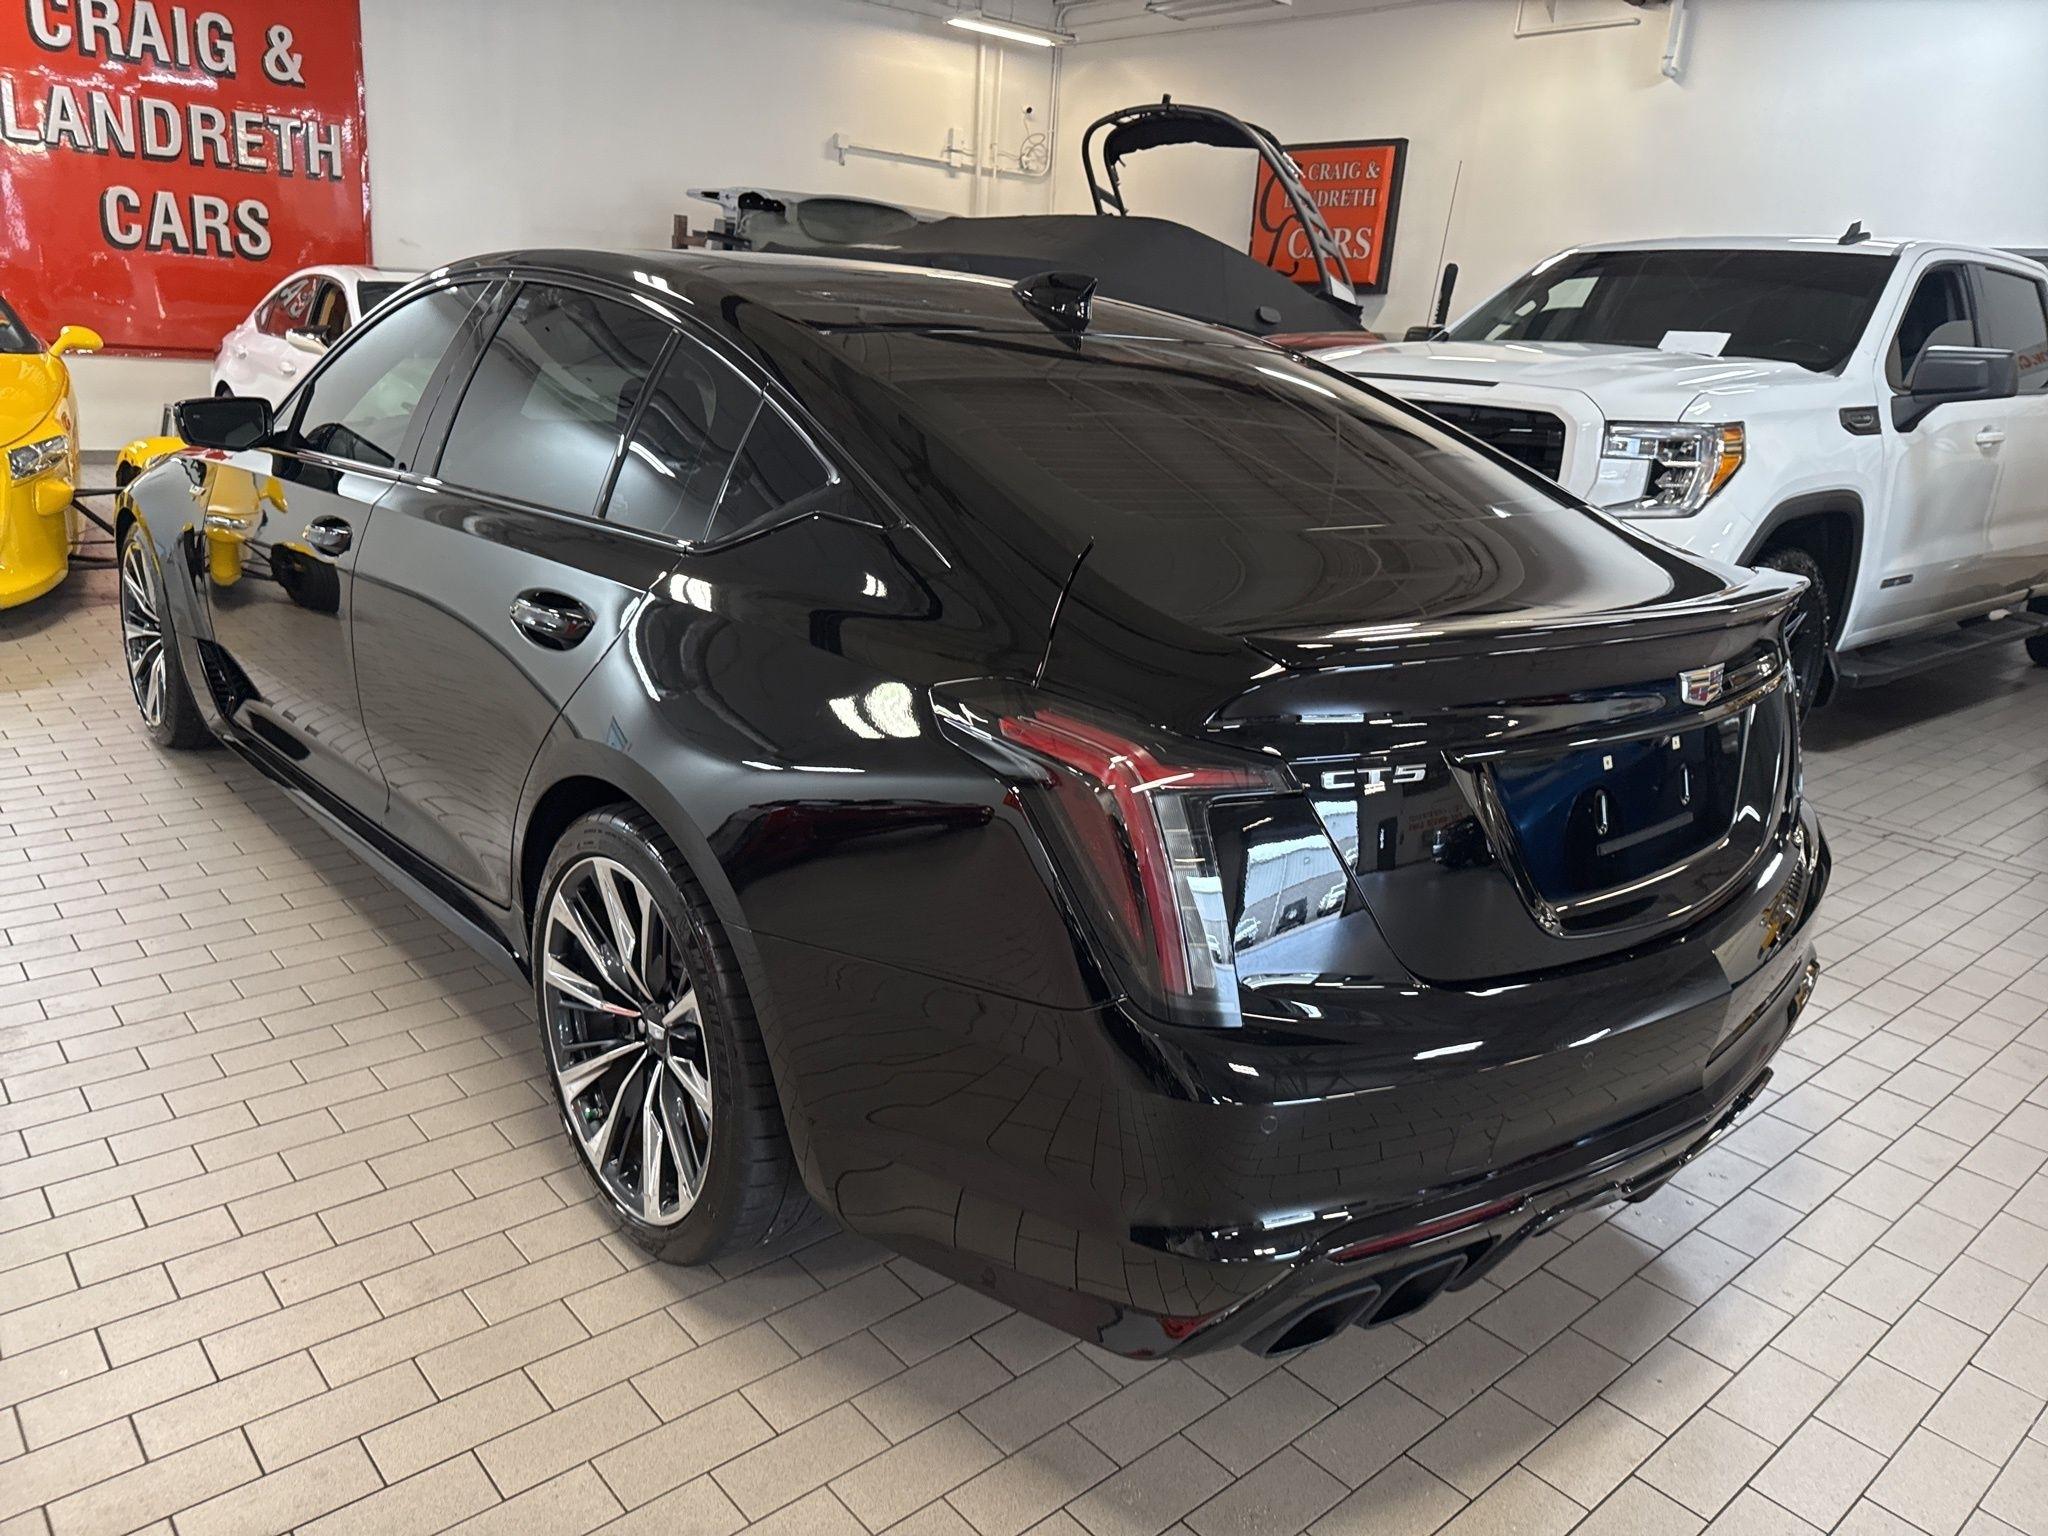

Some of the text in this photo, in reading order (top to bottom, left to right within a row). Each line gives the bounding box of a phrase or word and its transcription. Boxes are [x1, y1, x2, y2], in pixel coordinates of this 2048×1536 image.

[26, 0, 305, 88] CRAIG &
[0, 76, 343, 180] LANDRETH
[1283, 188, 1377, 209] LDRETH
[1308, 161, 1380, 181] CRAIG &
[102, 185, 272, 259] CARS
